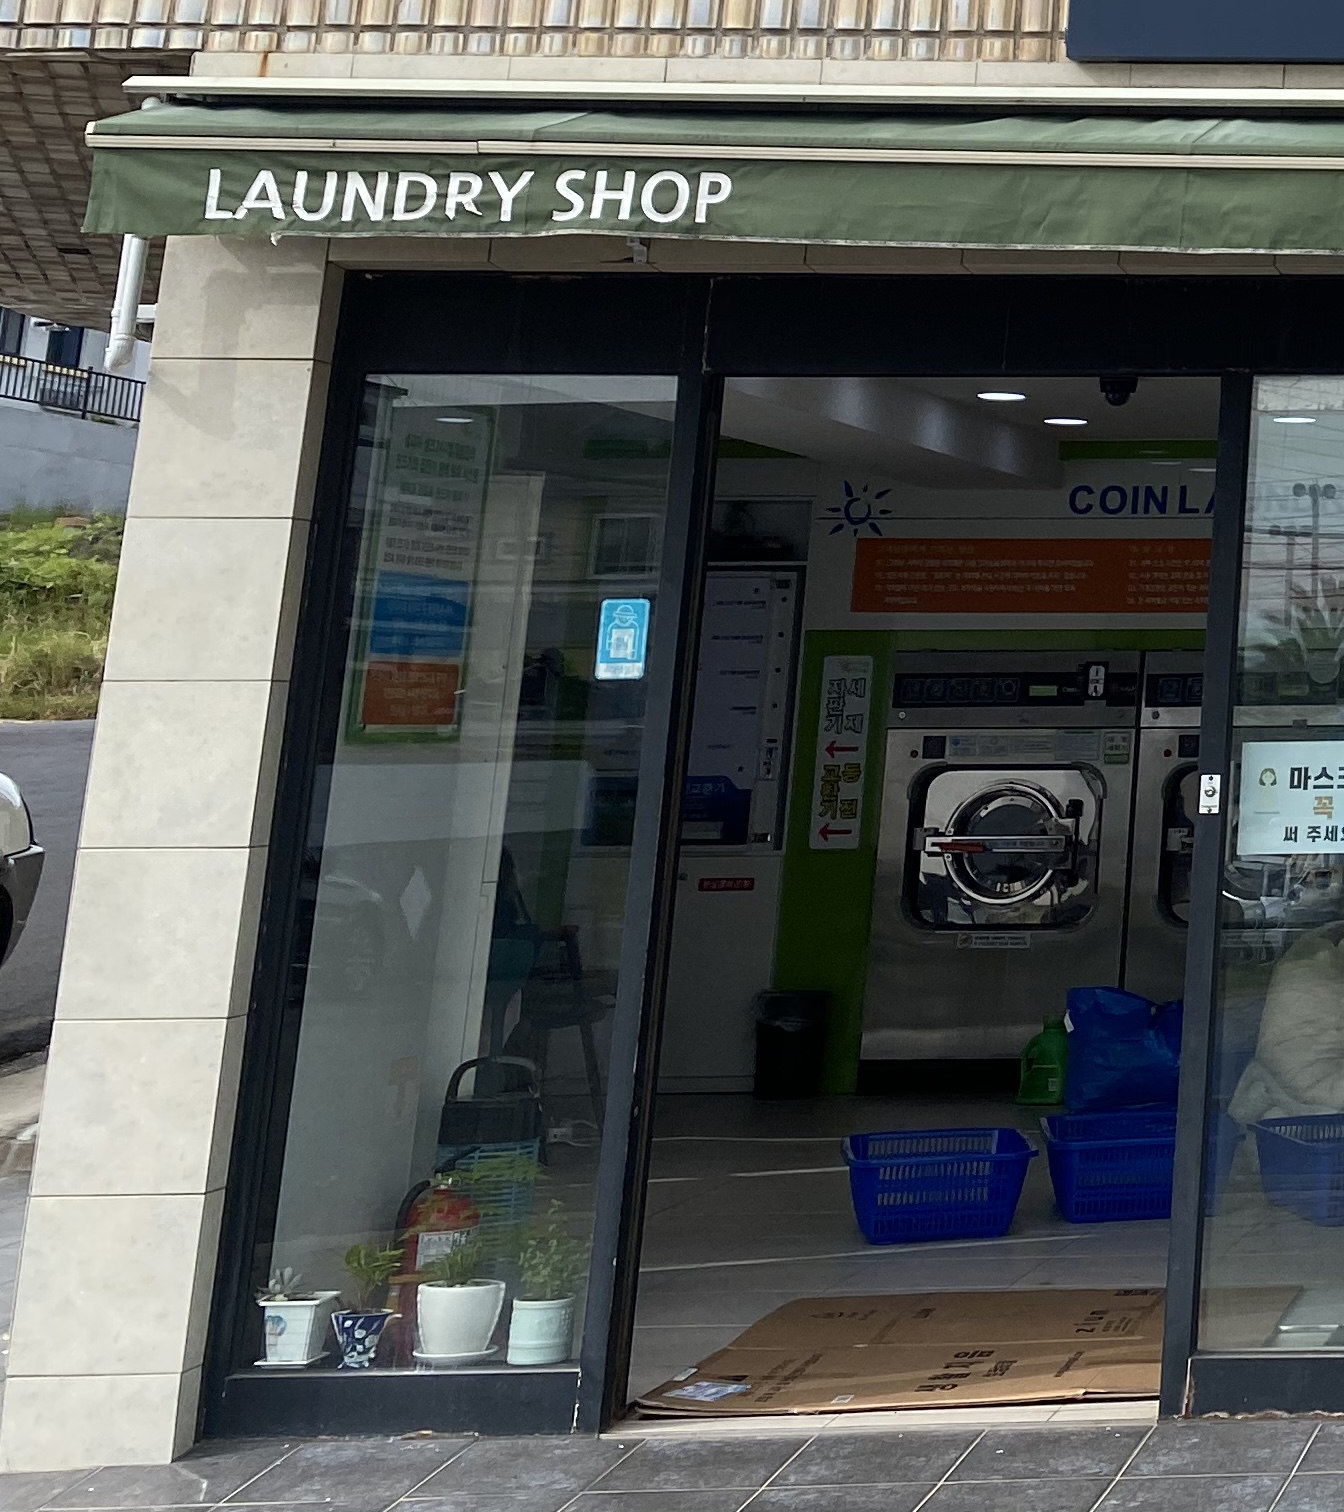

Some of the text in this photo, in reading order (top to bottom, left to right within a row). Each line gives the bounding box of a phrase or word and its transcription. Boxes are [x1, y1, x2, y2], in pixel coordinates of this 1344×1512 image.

[204, 168, 734, 224] LAUNDRY SHOP
[1068, 484, 1168, 516] COIN
[1313, 795, 1334, 820] 꼭
[1283, 826, 1298, 842] 써
